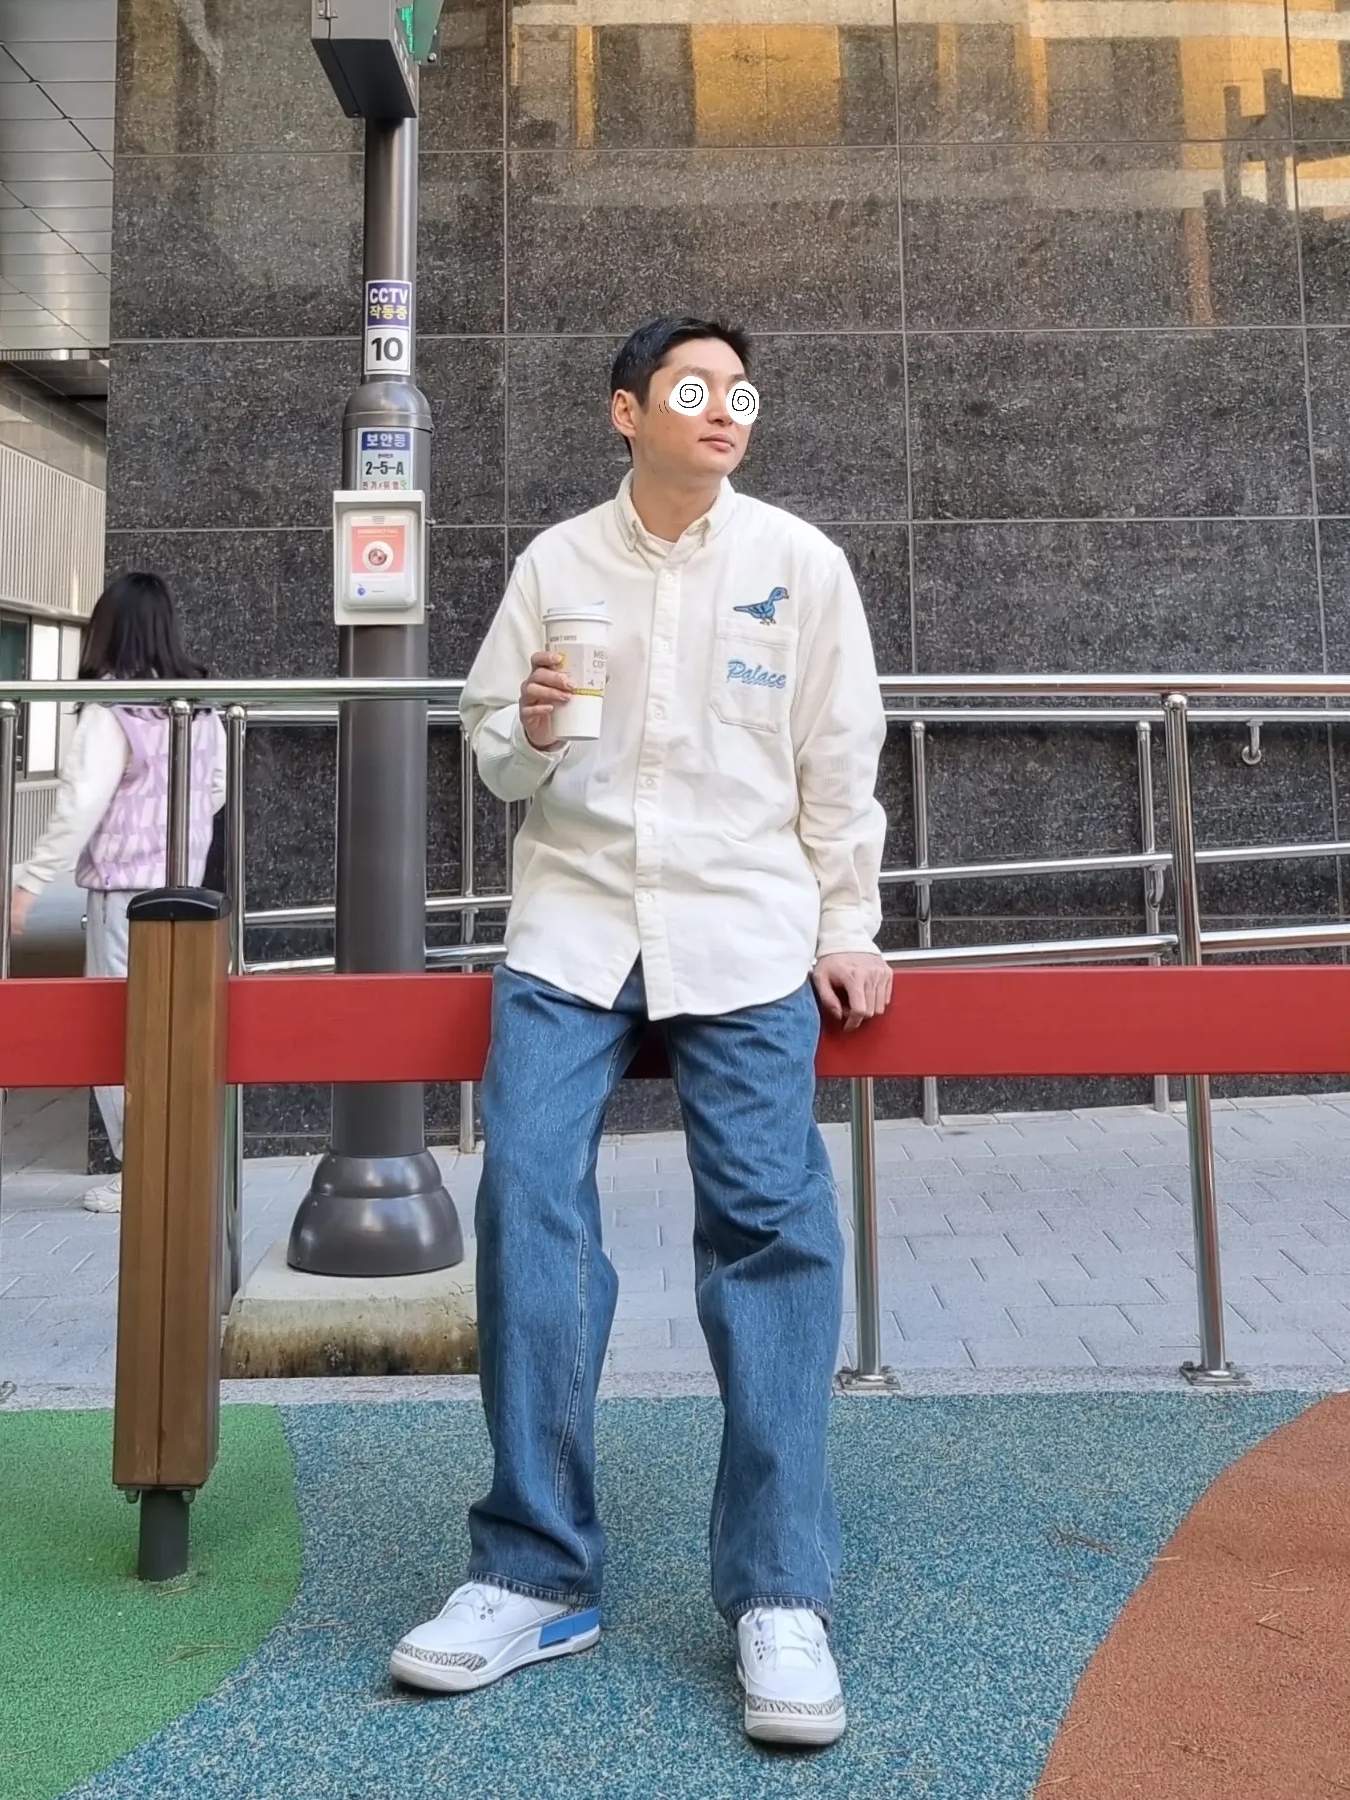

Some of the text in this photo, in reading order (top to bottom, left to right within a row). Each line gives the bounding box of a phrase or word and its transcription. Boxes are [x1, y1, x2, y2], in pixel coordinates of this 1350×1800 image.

[369, 287, 408, 304] CCTV
[369, 304, 408, 320] 작동중
[371, 337, 404, 362] 10
[366, 433, 407, 448] 보안등
[365, 461, 405, 476] 2-5-A
[727, 659, 787, 689] Palace
